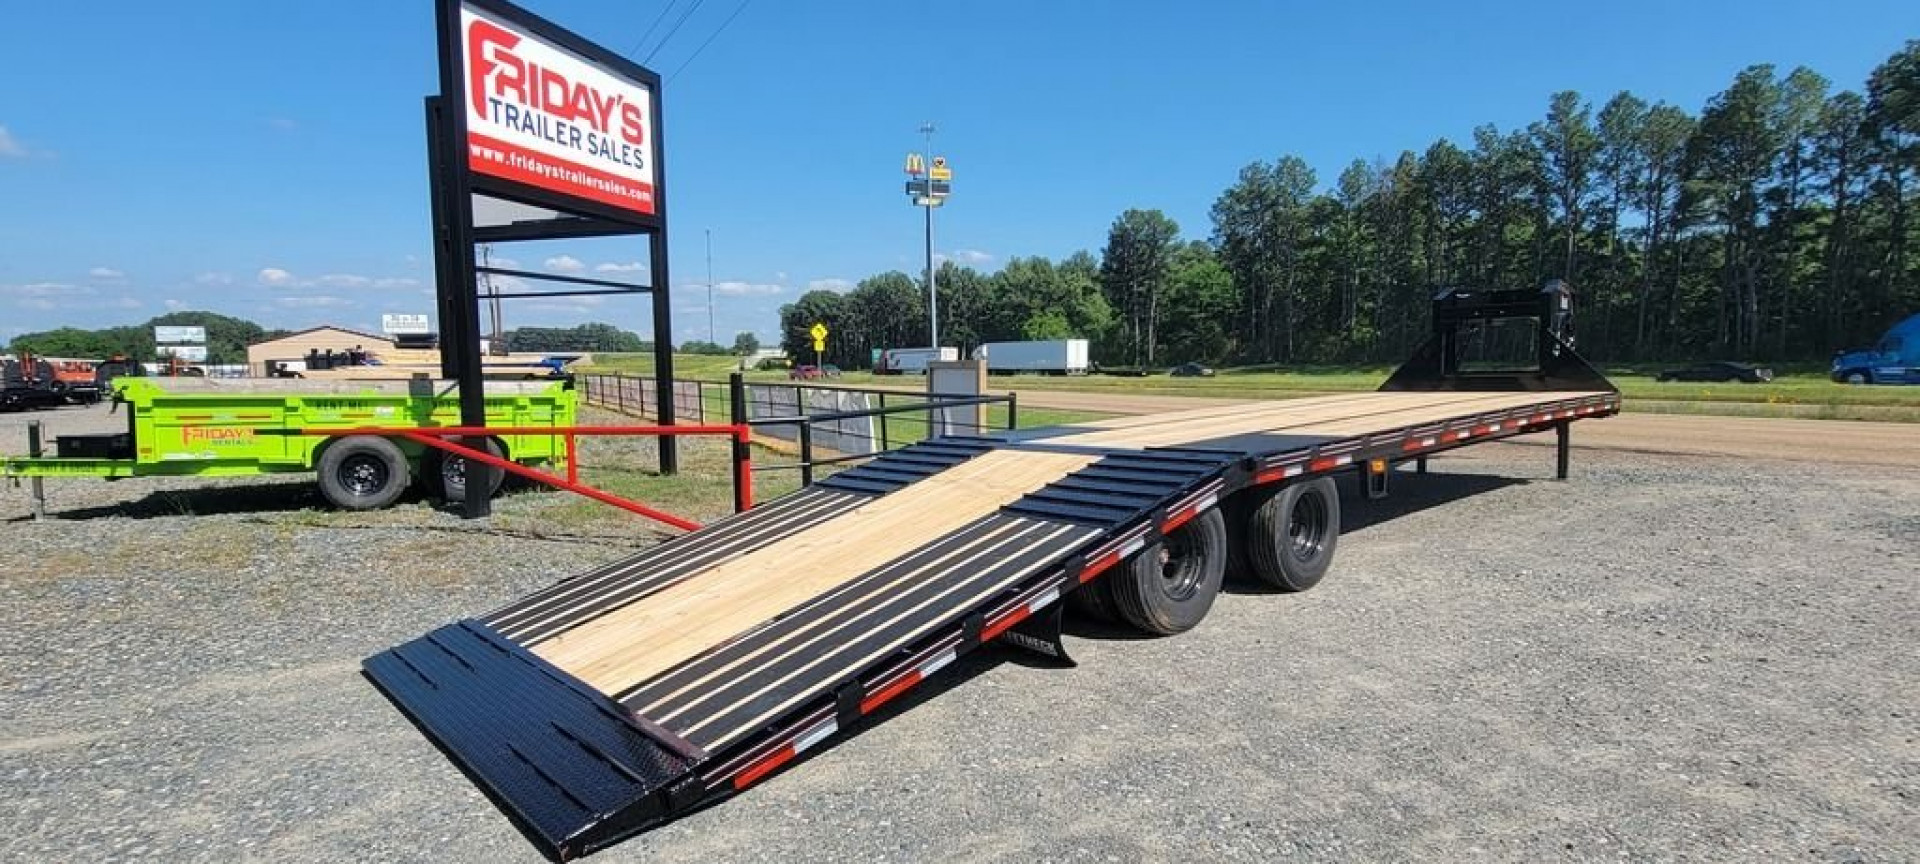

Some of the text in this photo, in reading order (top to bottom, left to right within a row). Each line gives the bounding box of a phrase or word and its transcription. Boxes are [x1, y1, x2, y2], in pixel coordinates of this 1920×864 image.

[469, 20, 643, 145] FRIDAY'S
[489, 97, 644, 169] TRAILER SALES
[471, 144, 650, 200] www.fridaystrailersales.com
